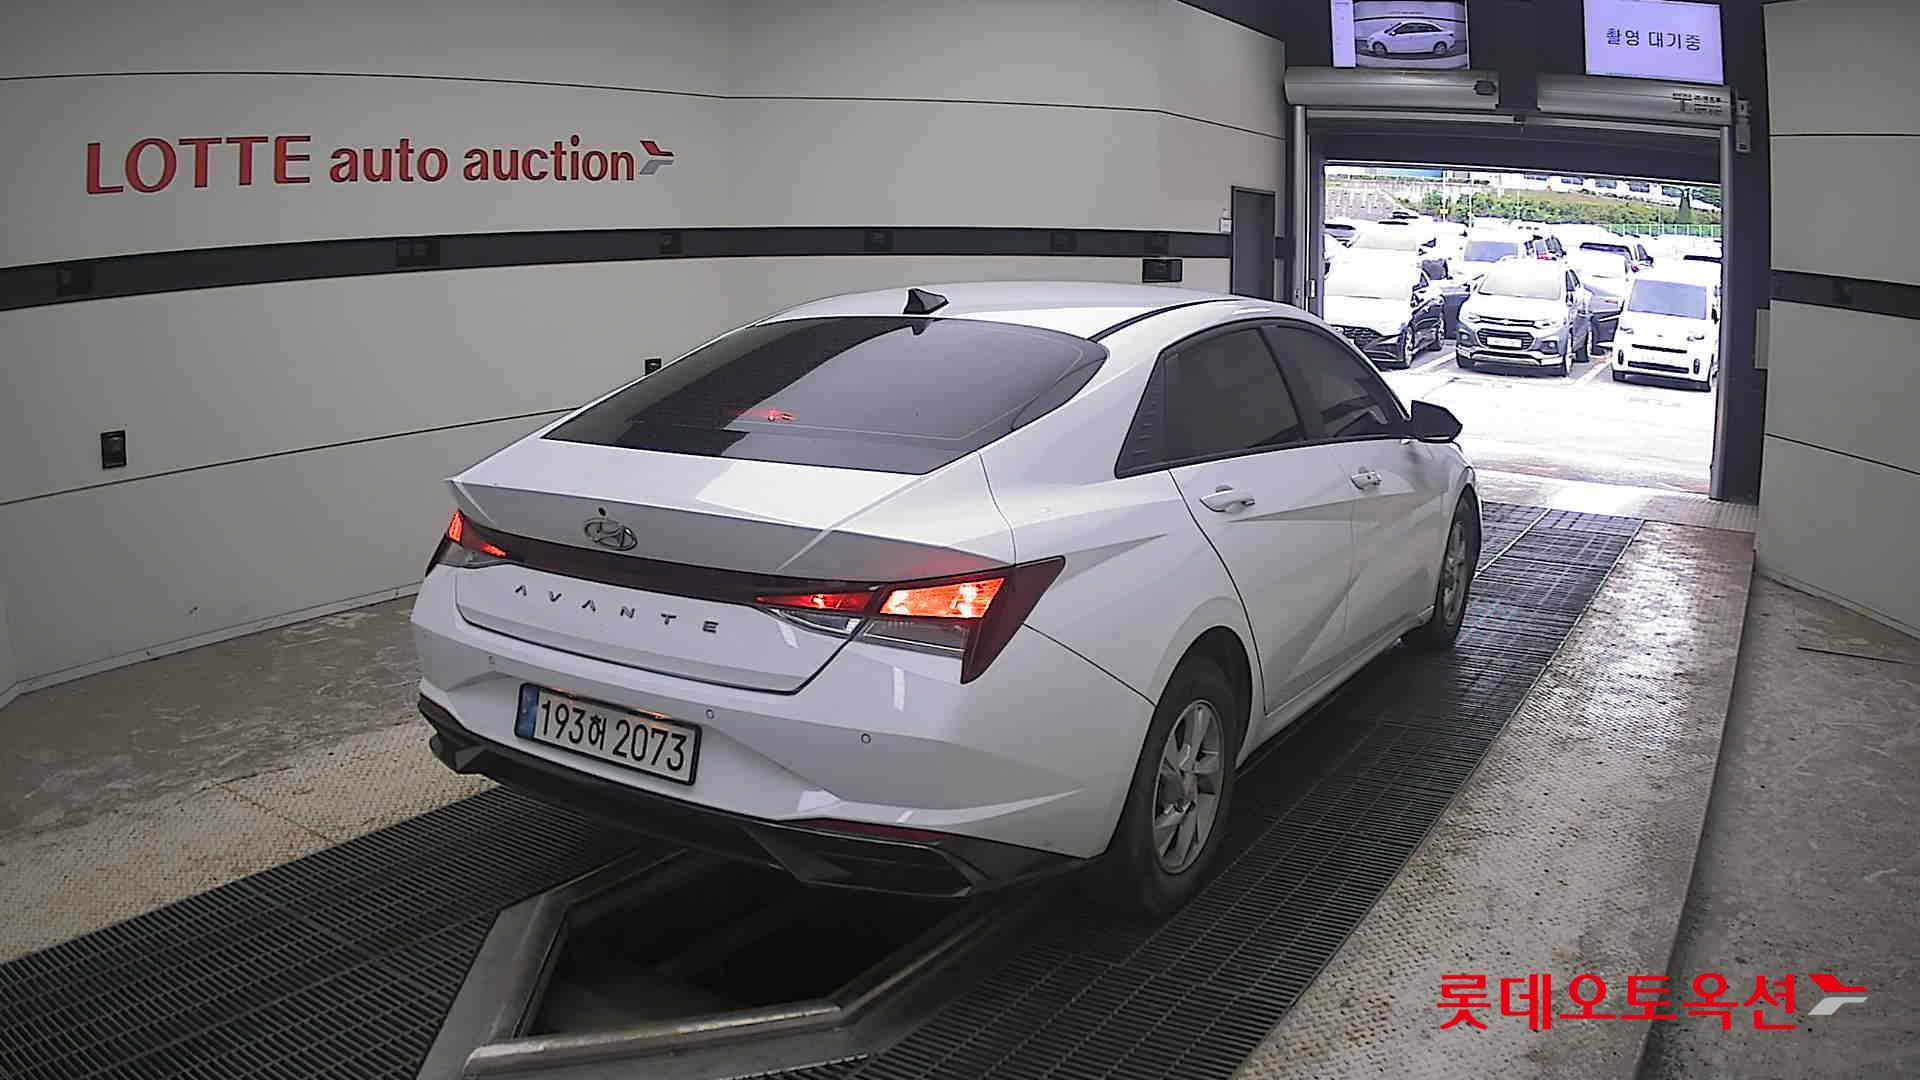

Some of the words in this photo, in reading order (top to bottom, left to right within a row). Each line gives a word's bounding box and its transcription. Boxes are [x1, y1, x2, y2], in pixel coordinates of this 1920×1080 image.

[1606, 28, 1640, 46] 촬영
[1648, 31, 1701, 51] 대기중
[86, 135, 312, 195] LOTTE
[329, 138, 449, 183] auto
[463, 134, 635, 182] auction
[514, 584, 719, 634] AVANTE
[541, 699, 607, 751] 193허
[612, 719, 688, 772] 2073
